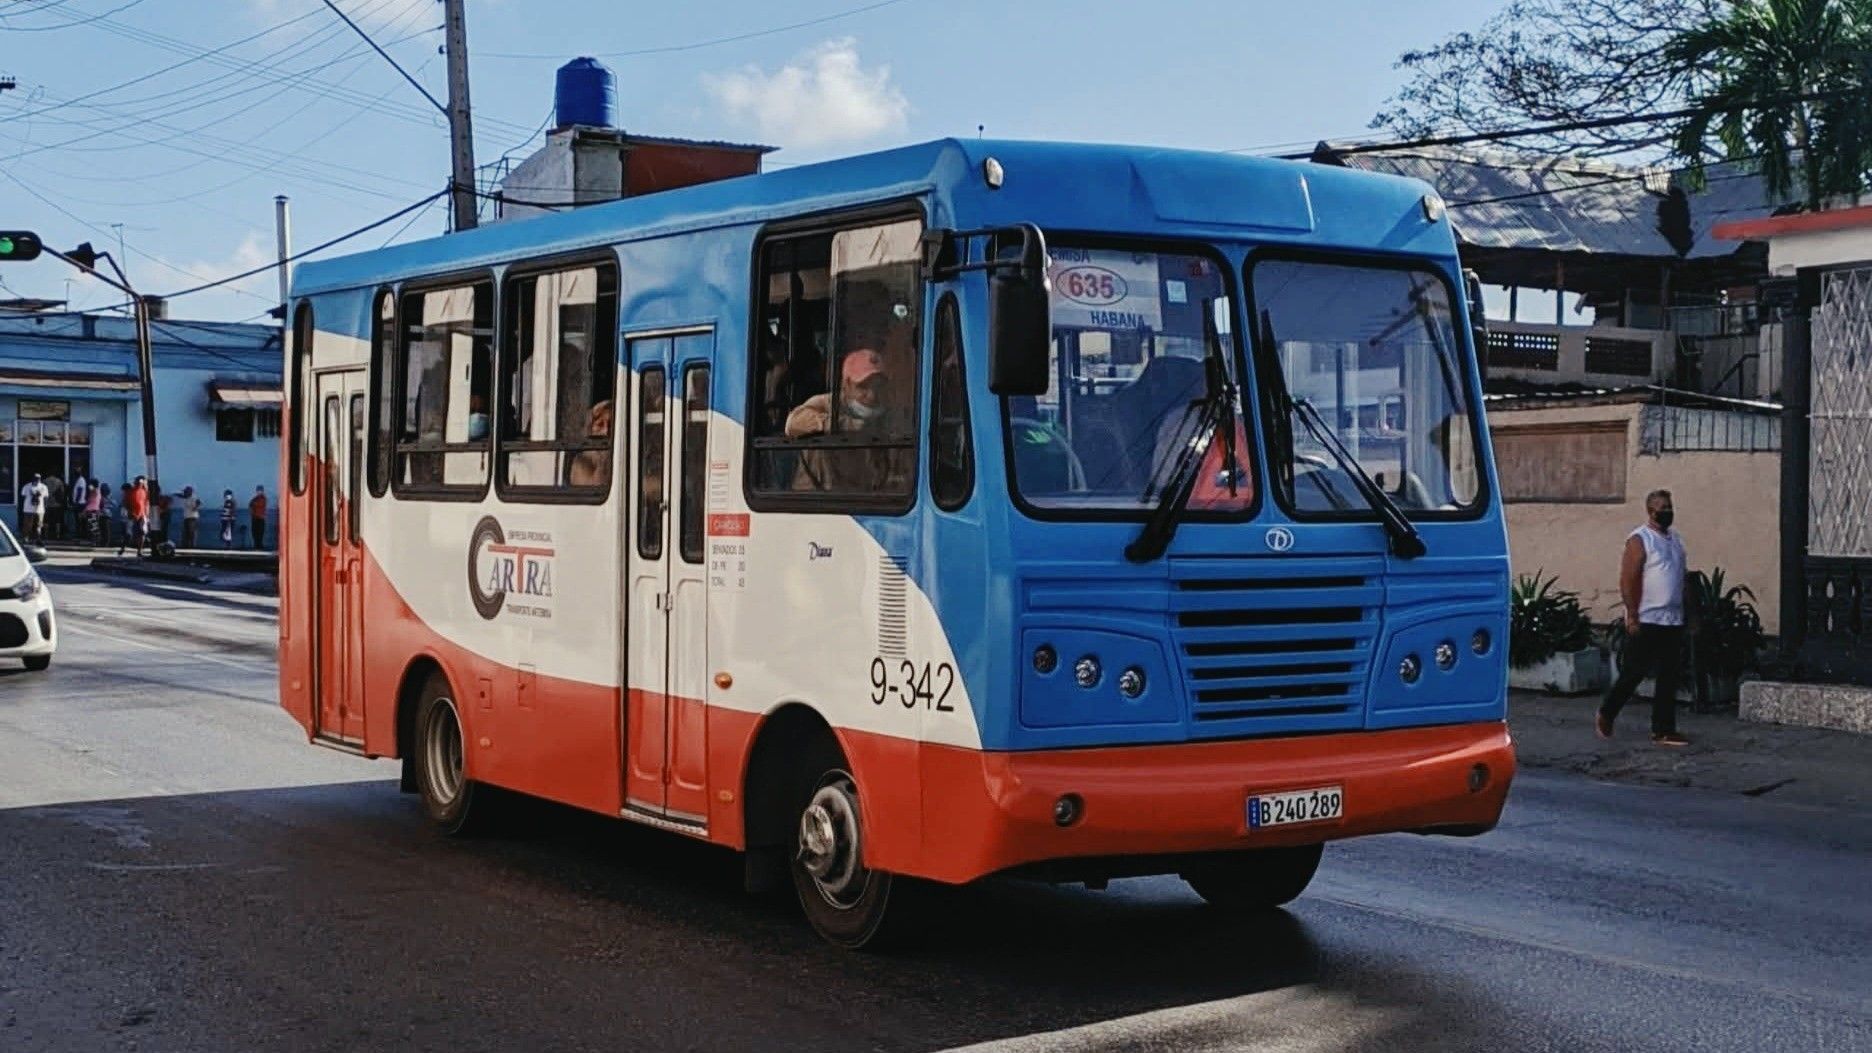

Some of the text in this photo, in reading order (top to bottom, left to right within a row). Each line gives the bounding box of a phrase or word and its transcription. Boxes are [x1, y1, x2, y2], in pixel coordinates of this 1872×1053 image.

[1069, 273, 1114, 299] 635
[1090, 311, 1145, 327] HABANA
[871, 657, 954, 712] 9-342
[1261, 802, 1271, 824] B
[1275, 798, 1306, 822] 240
[1310, 793, 1340, 818] 289
